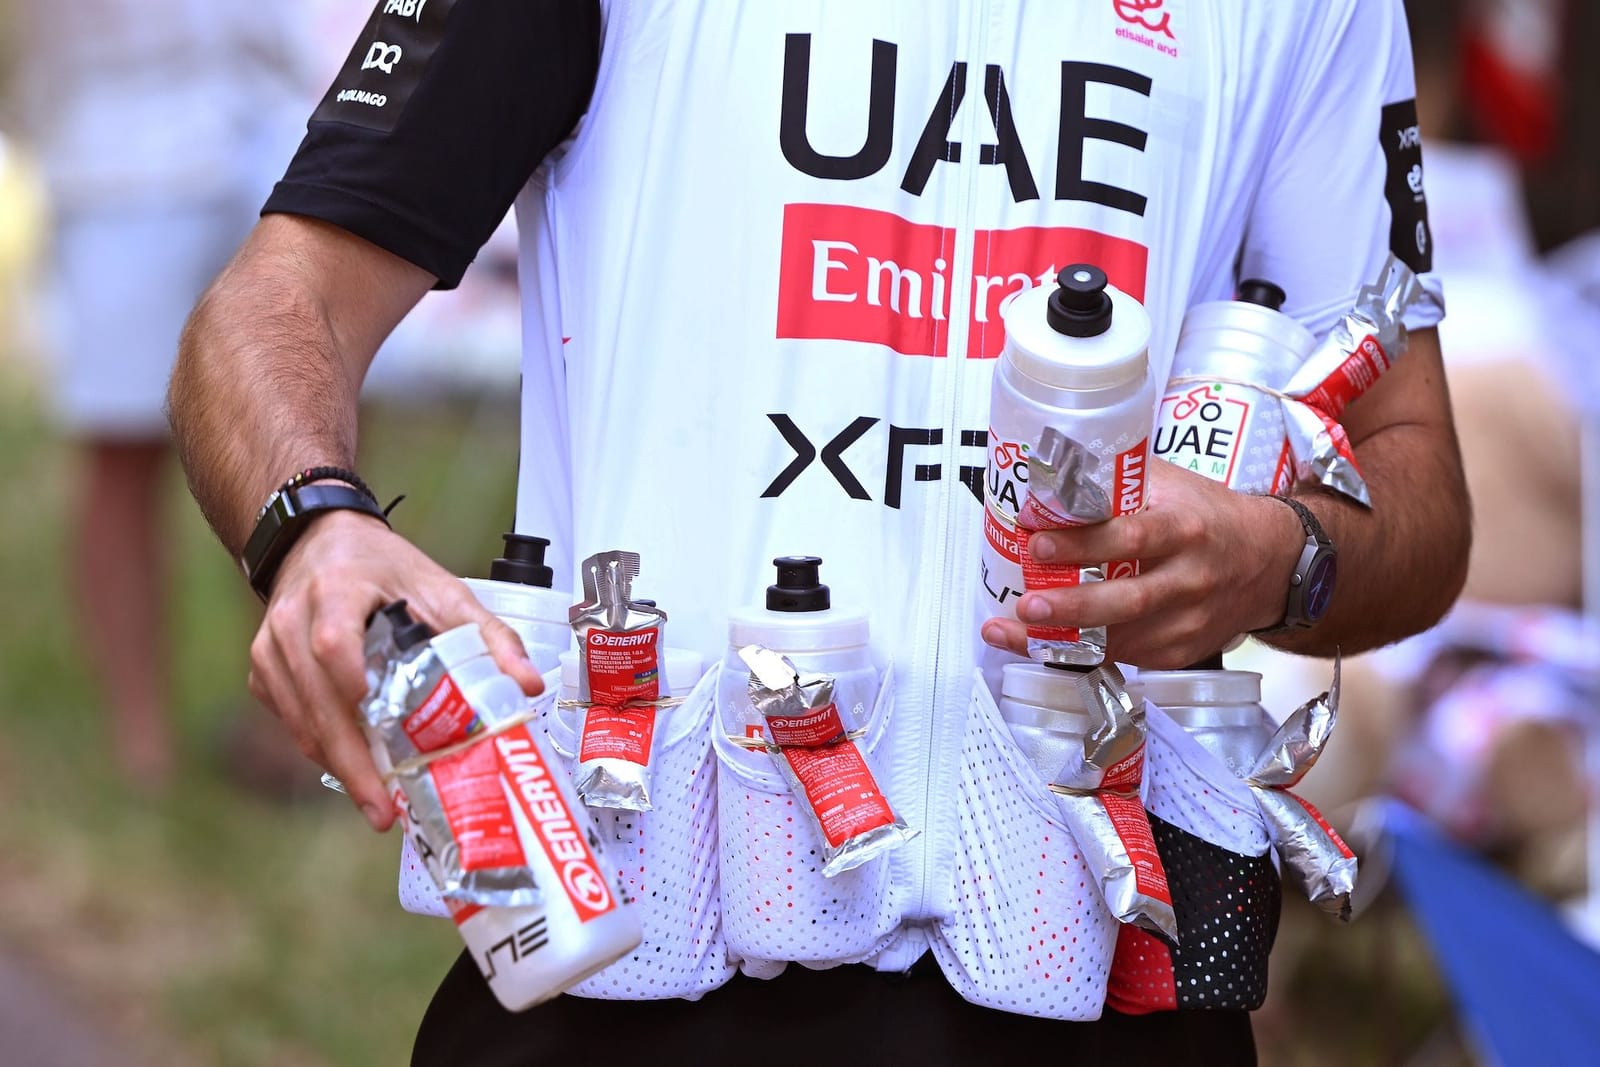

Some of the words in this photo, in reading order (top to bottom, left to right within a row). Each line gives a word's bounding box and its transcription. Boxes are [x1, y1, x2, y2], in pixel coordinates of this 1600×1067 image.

[1115, 27, 1154, 48] etisalat
[1157, 42, 1177, 57] and
[780, 33, 1152, 217] UAE
[1153, 424, 1233, 459] UAE
[1168, 456, 1227, 475] EAM
[988, 459, 1020, 514] UA
[1121, 451, 1146, 517] RVIT
[985, 520, 1020, 554] Emira
[606, 632, 654, 647] ENERVIT
[788, 707, 832, 728] ENERVIT
[495, 735, 583, 862] ENERVIT
